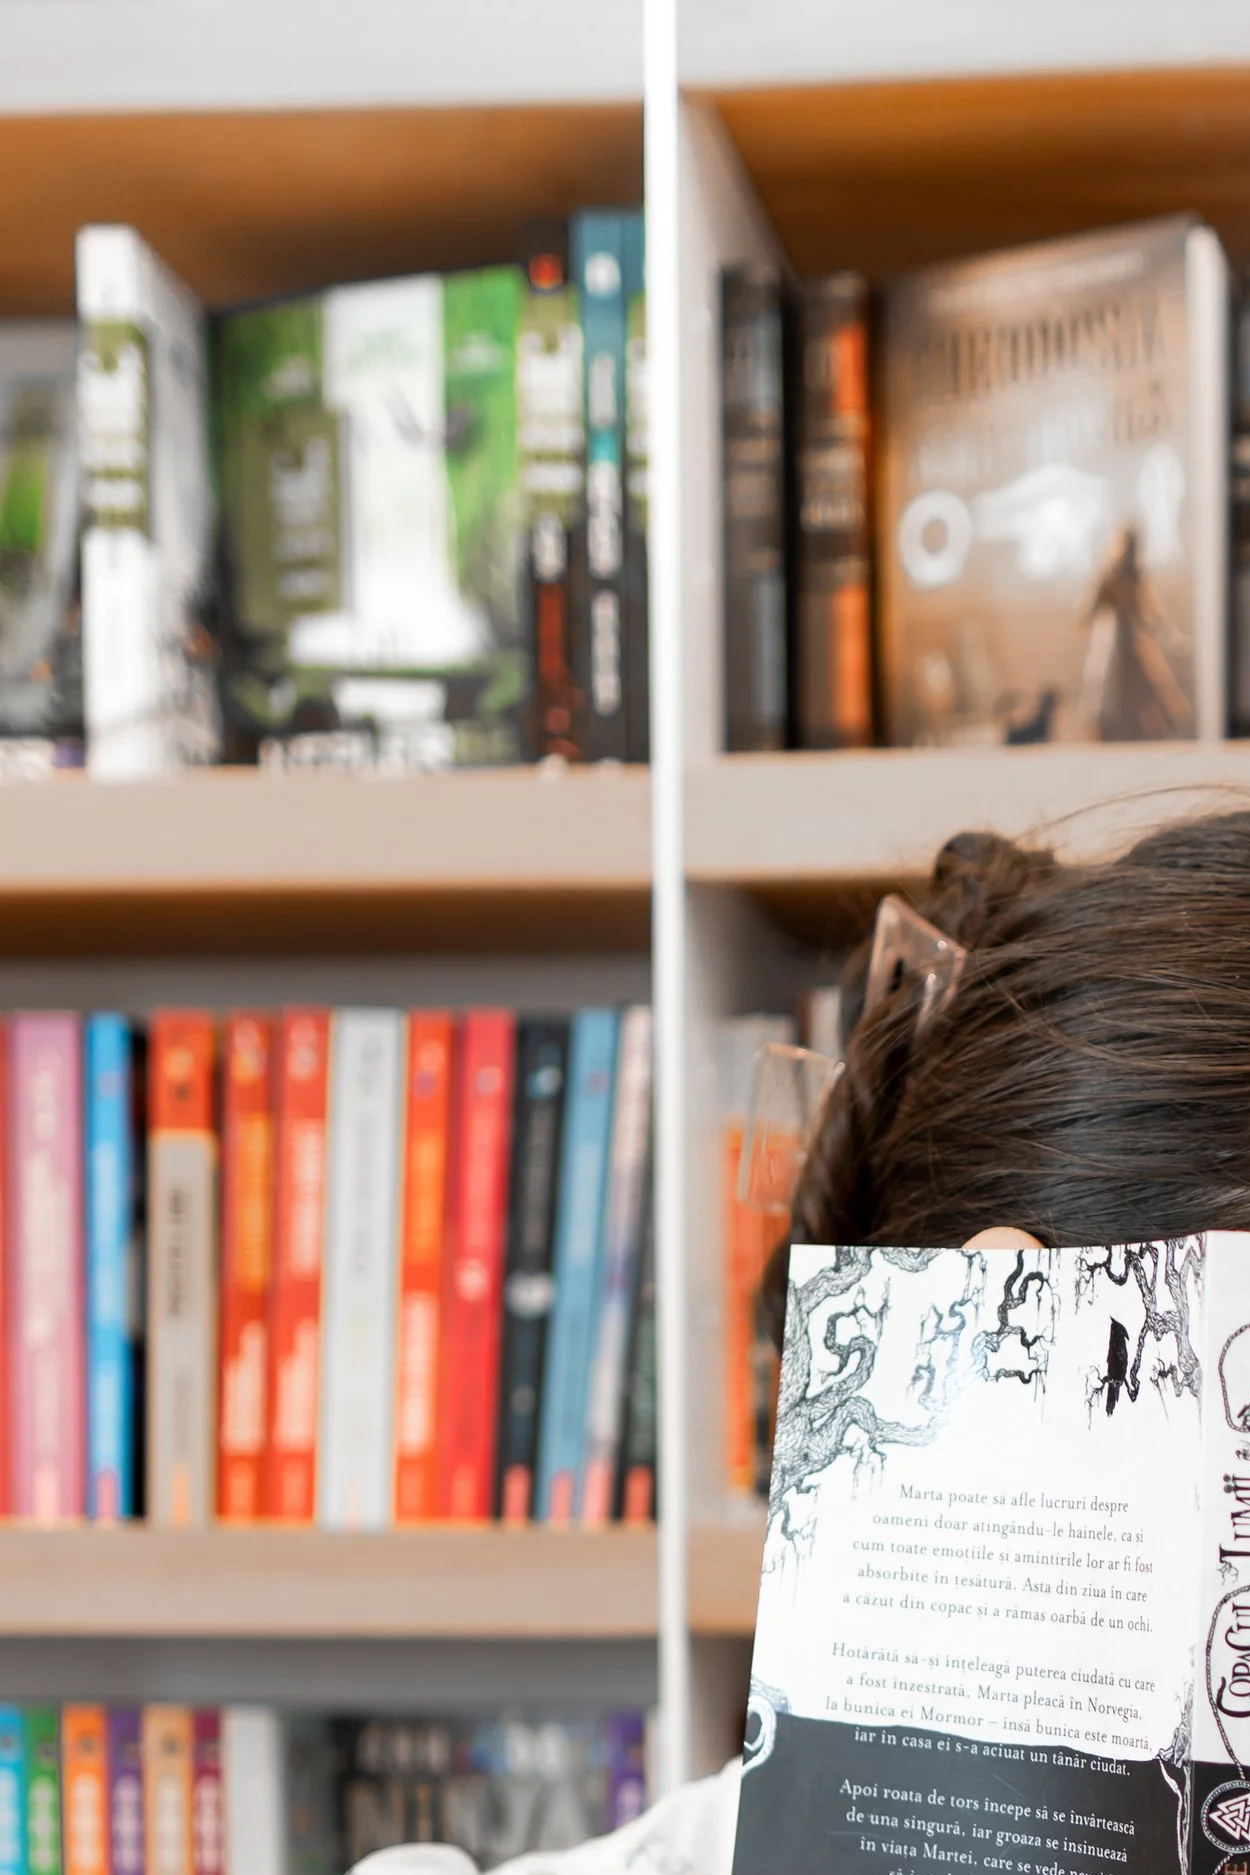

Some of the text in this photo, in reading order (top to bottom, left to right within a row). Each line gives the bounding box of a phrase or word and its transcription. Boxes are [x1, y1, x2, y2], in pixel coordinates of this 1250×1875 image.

[900, 1483, 943, 1502] Marta
[948, 1492, 988, 1508] poate
[1011, 1490, 1035, 1508] afle
[1041, 1492, 1086, 1511] lucruri
[1090, 1495, 1129, 1518] despre
[873, 1514, 929, 1528] oameni
[934, 1513, 968, 1531] doar
[1068, 1524, 1116, 1543] hainele,
[1121, 1531, 1132, 1543] ca
[853, 1540, 885, 1552] cum
[890, 1542, 927, 1556] toate
[1014, 1551, 1082, 1568] amintirile
[1086, 1552, 1104, 1570] lor
[1108, 1560, 1120, 1571] ar
[1123, 1555, 1131, 1572] fi
[1135, 1555, 1153, 1575] fost
[858, 1562, 928, 1584] absorbite
[1022, 1576, 1051, 1594] Asta
[1056, 1578, 1077, 1596] din
[1082, 1583, 1106, 1599] ziua
[1126, 1590, 1147, 1603] care
[843, 1593, 850, 1604] a
[900, 1593, 925, 1611] din
[931, 1602, 972, 1619] copac
[993, 1607, 1000, 1617] a
[1090, 1610, 1105, 1628] de
[1108, 1618, 1124, 1630] un
[1127, 1615, 1153, 1633] ochi.
[846, 1675, 853, 1686] a
[859, 1671, 886, 1689] fost
[978, 1683, 1019, 1704] Marta
[1087, 1696, 1142, 1724] Norvegia,
[1016, 1665, 1067, 1681] puterea
[1119, 1677, 1131, 1689] cu
[1135, 1679, 1155, 1693] care
[825, 1694, 838, 1711] la
[844, 1696, 895, 1717] bunica
[901, 1705, 914, 1720] ei
[920, 1705, 983, 1727] Mormor
[1036, 1718, 1080, 1740] bunica
[1085, 1730, 1107, 1744] este
[855, 1729, 876, 1743] iar
[902, 1736, 932, 1750] casa
[937, 1737, 950, 1752] ei
[955, 1742, 978, 1755] s-a
[983, 1745, 1025, 1761] aciuat
[1030, 1751, 1048, 1764] un
[1090, 1759, 1130, 1777] ciudat.
[839, 1778, 878, 1801] Apoi
[883, 1787, 922, 1804] roata
[927, 1788, 945, 1806] de
[950, 1795, 979, 1811] tors
[984, 1797, 1031, 1822] începe
[1035, 1805, 1048, 1820] să
[1053, 1810, 1066, 1823] se
[846, 1805, 864, 1824] de
[867, 1813, 898, 1828] una
[972, 1823, 992, 1840] iar
[996, 1830, 1041, 1847] groaza
[1046, 1838, 1059, 1850] se
[860, 1835, 876, 1852] în
[881, 1839, 917, 1859] viața
[923, 1842, 978, 1867] Martei,
[983, 1856, 1013, 1871] care
[1017, 1861, 1031, 1874] se
